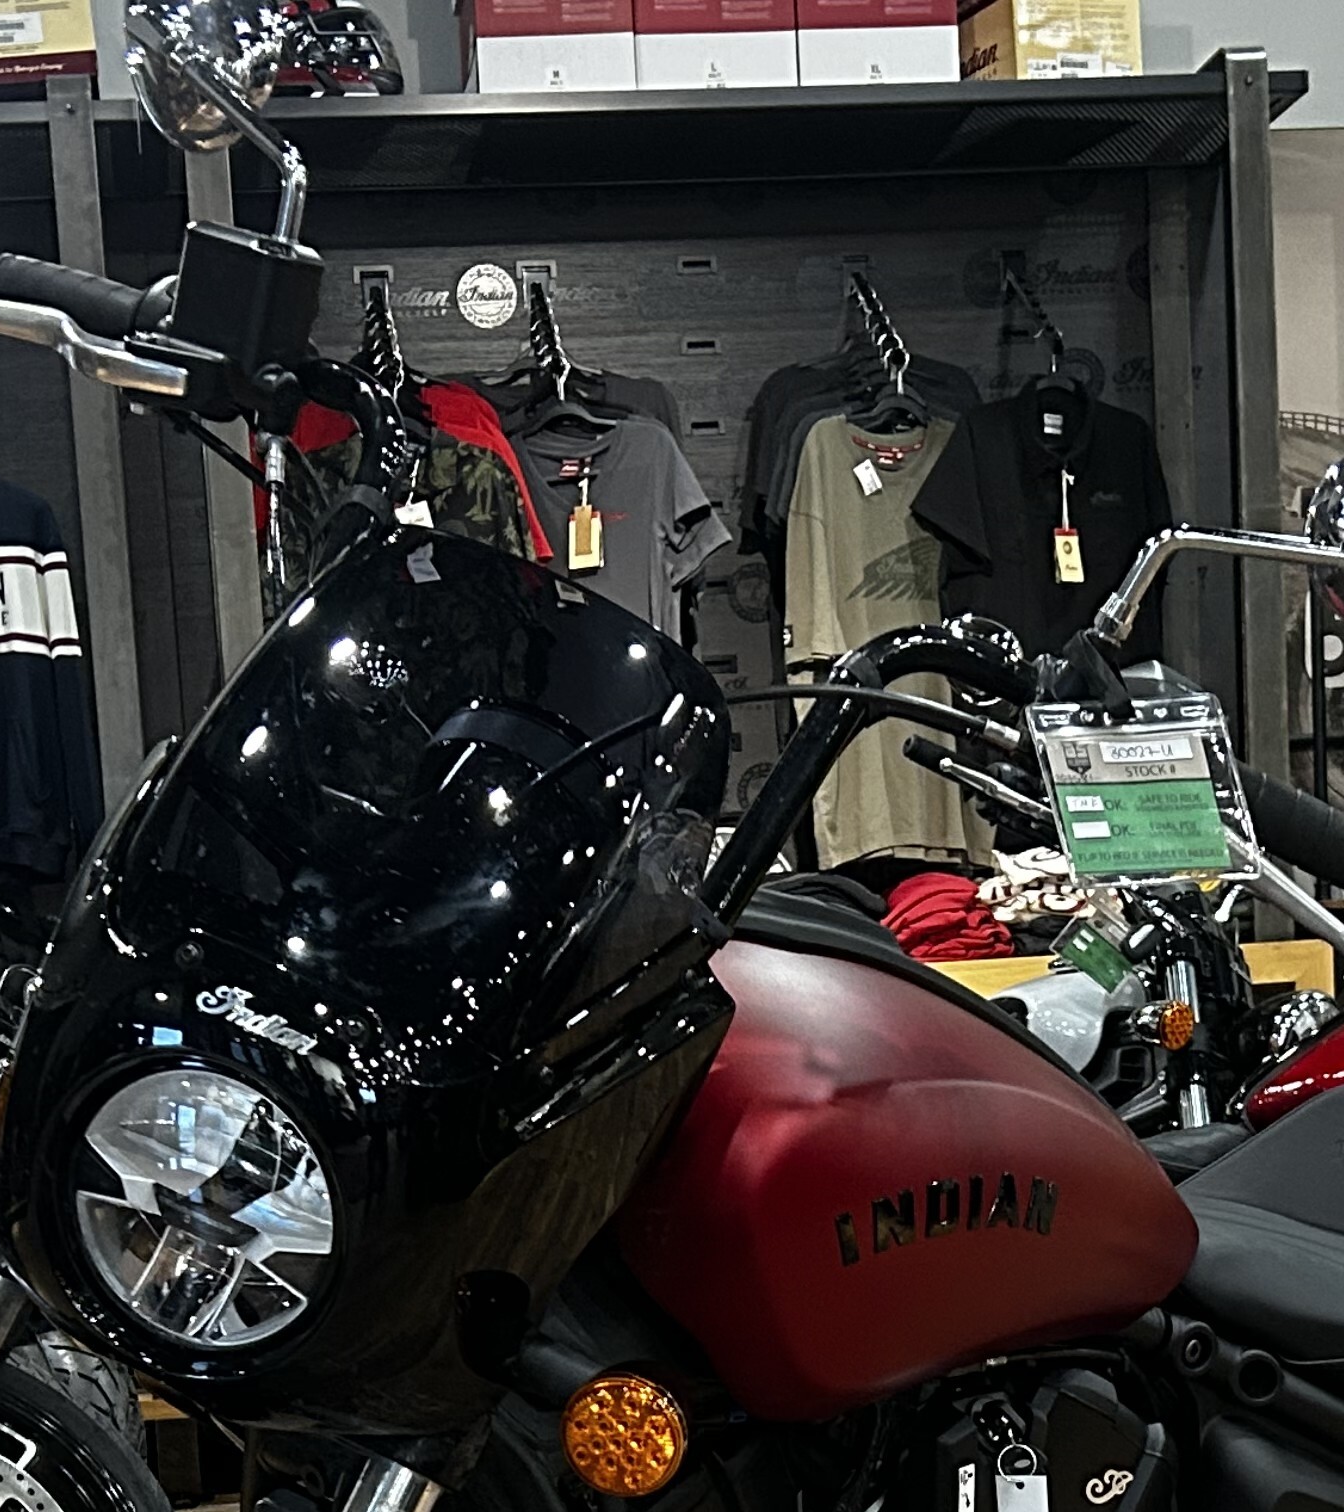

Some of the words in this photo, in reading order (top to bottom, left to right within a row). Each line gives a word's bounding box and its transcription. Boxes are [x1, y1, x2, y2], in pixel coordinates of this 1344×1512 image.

[389, 287, 452, 308] ndian
[1125, 763, 1166, 779] STOCK
[196, 985, 318, 1056] Indian
[834, 1170, 1060, 1268] INDIAN
